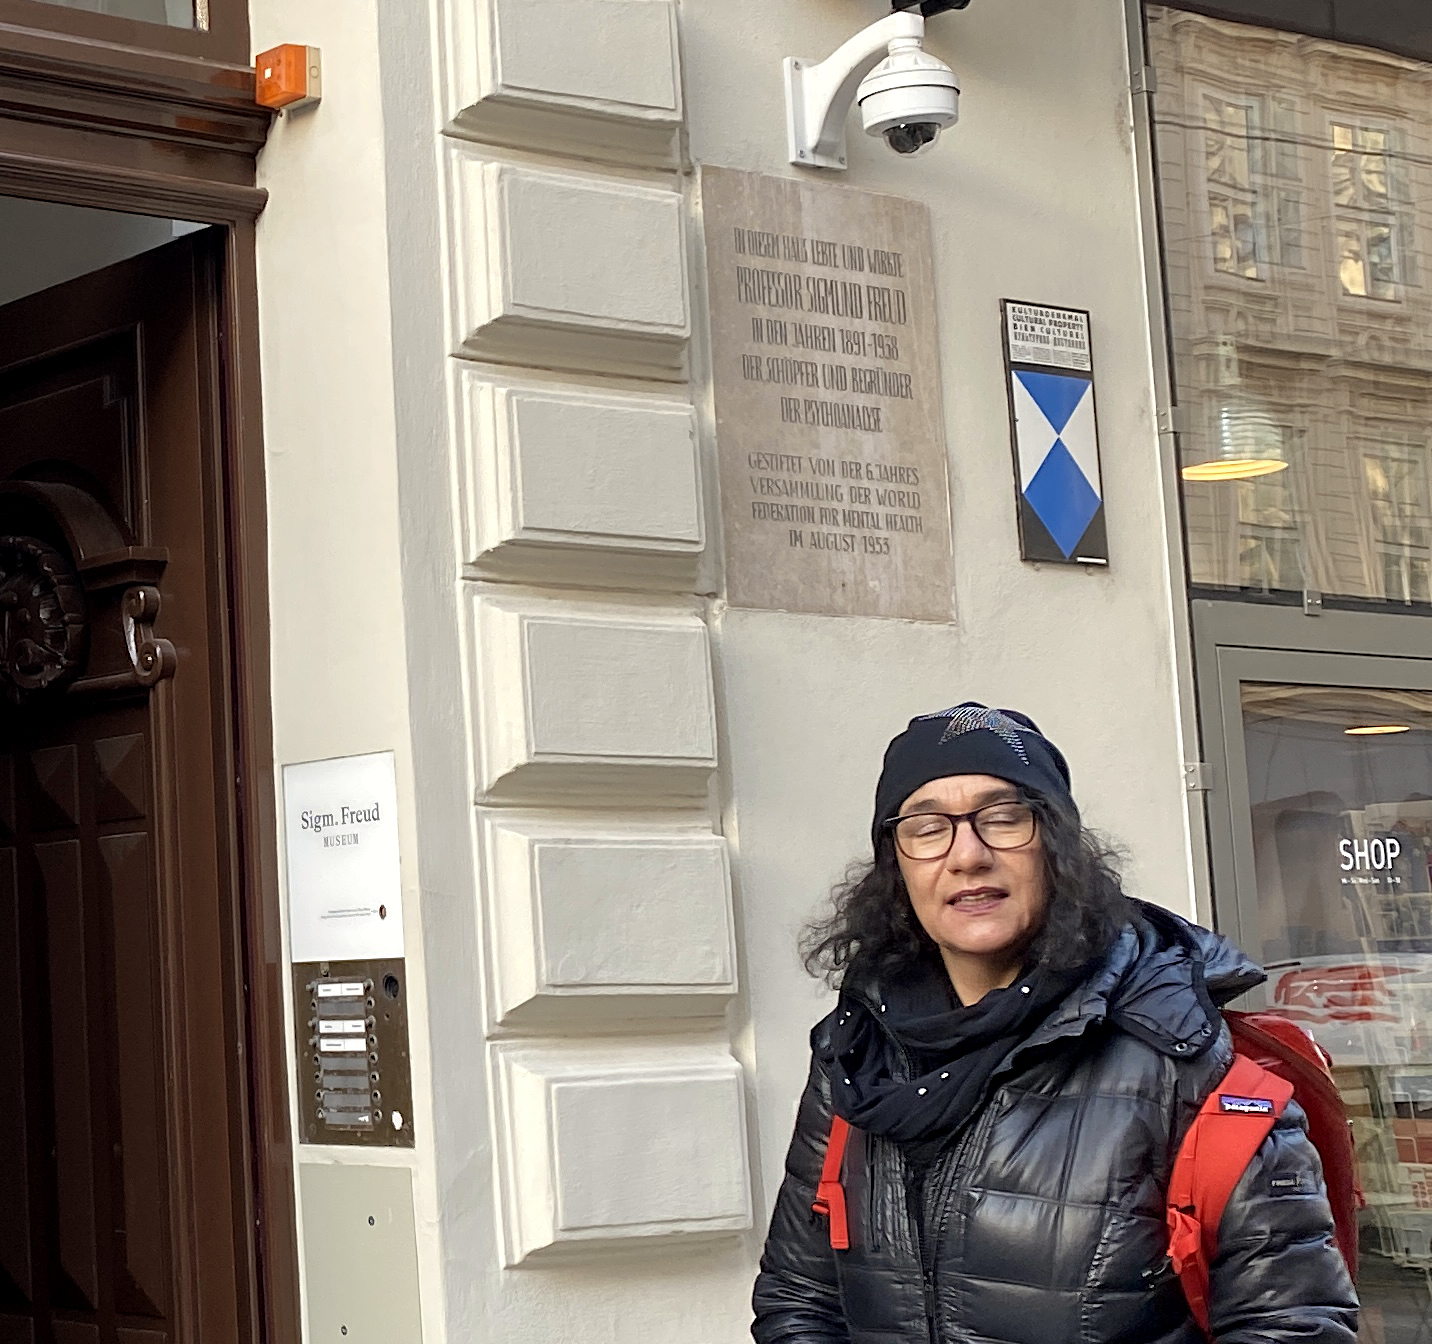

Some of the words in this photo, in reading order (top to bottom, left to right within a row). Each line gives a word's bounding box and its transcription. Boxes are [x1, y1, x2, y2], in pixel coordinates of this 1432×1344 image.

[810, 238, 839, 269] LEBTE
[841, 243, 865, 273] UND
[866, 247, 904, 279] WIRKTE
[736, 265, 805, 312] PROFESSOR
[806, 276, 864, 320] SIGMUND
[866, 284, 907, 325] FREUD
[751, 317, 764, 344] IN
[766, 318, 788, 347] DEN
[791, 321, 837, 354] JAHREN
[742, 353, 766, 383] DER
[765, 356, 820, 389] SCHÖPFER
[822, 363, 848, 392] UND
[851, 366, 914, 401] BEGRÜNDER
[781, 396, 802, 424] DER
[804, 399, 883, 433] PSYCHOANALYSE
[748, 452, 803, 474] GESTIFTET
[808, 456, 836, 478] VON
[841, 460, 863, 480] DER
[749, 475, 844, 503] VERSAMMLUNG
[849, 485, 872, 505] DER
[875, 487, 922, 510] WORLD
[752, 501, 816, 525] FEDERATION
[819, 506, 841, 528] FOR
[842, 508, 883, 531] MENTAL
[885, 512, 924, 534] HEALTH
[789, 529, 804, 549] IM
[809, 530, 856, 553] AUGUST
[861, 535, 891, 556] 1953
[301, 809, 339, 833] Sigm.
[340, 801, 381, 825] Freud
[323, 832, 360, 848] MUSEUM
[1339, 838, 1401, 871] SHOP
